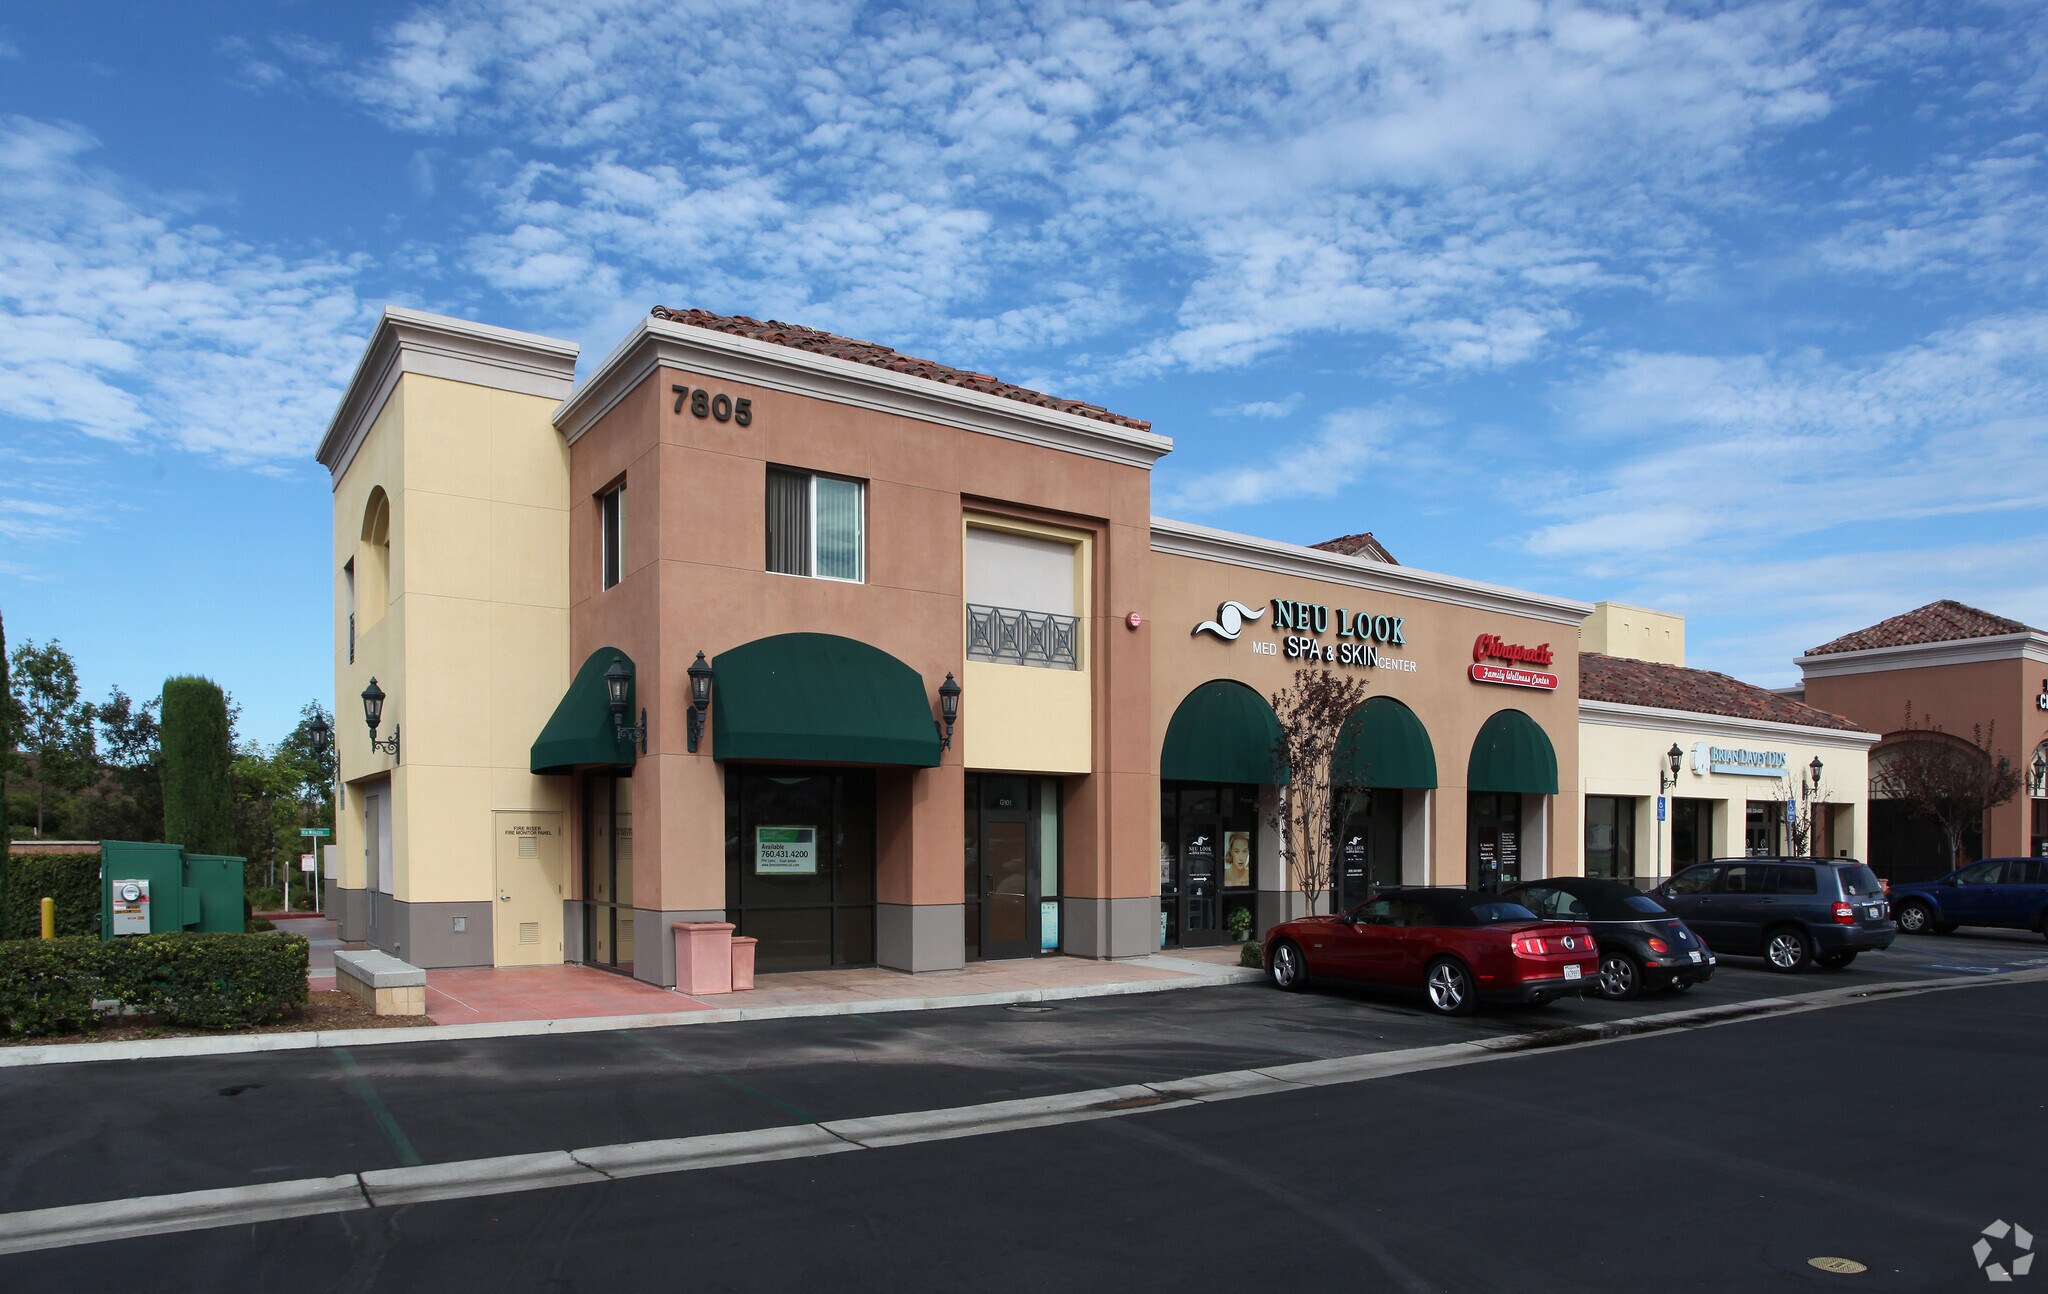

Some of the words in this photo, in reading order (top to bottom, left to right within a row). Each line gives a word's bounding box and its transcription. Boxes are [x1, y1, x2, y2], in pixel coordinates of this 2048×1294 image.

[672, 384, 752, 426] 7805
[1272, 599, 1330, 633] NEU
[1338, 608, 1407, 645] LOOK
[1252, 641, 1277, 656] MED
[1286, 635, 1322, 660] SPA
[1326, 645, 1335, 662] &
[1340, 642, 1379, 667] SKIN
[1378, 656, 1417, 673] CENTER
[1473, 633, 1553, 667] Chiropractic
[1483, 667, 1505, 681] Family
[1505, 670, 1531, 683] Wellness
[1531, 674, 1550, 685] Center
[1712, 746, 1739, 764] BRIAN
[1768, 751, 1788, 767] DDS
[761, 850, 809, 858] 760.431.4200
